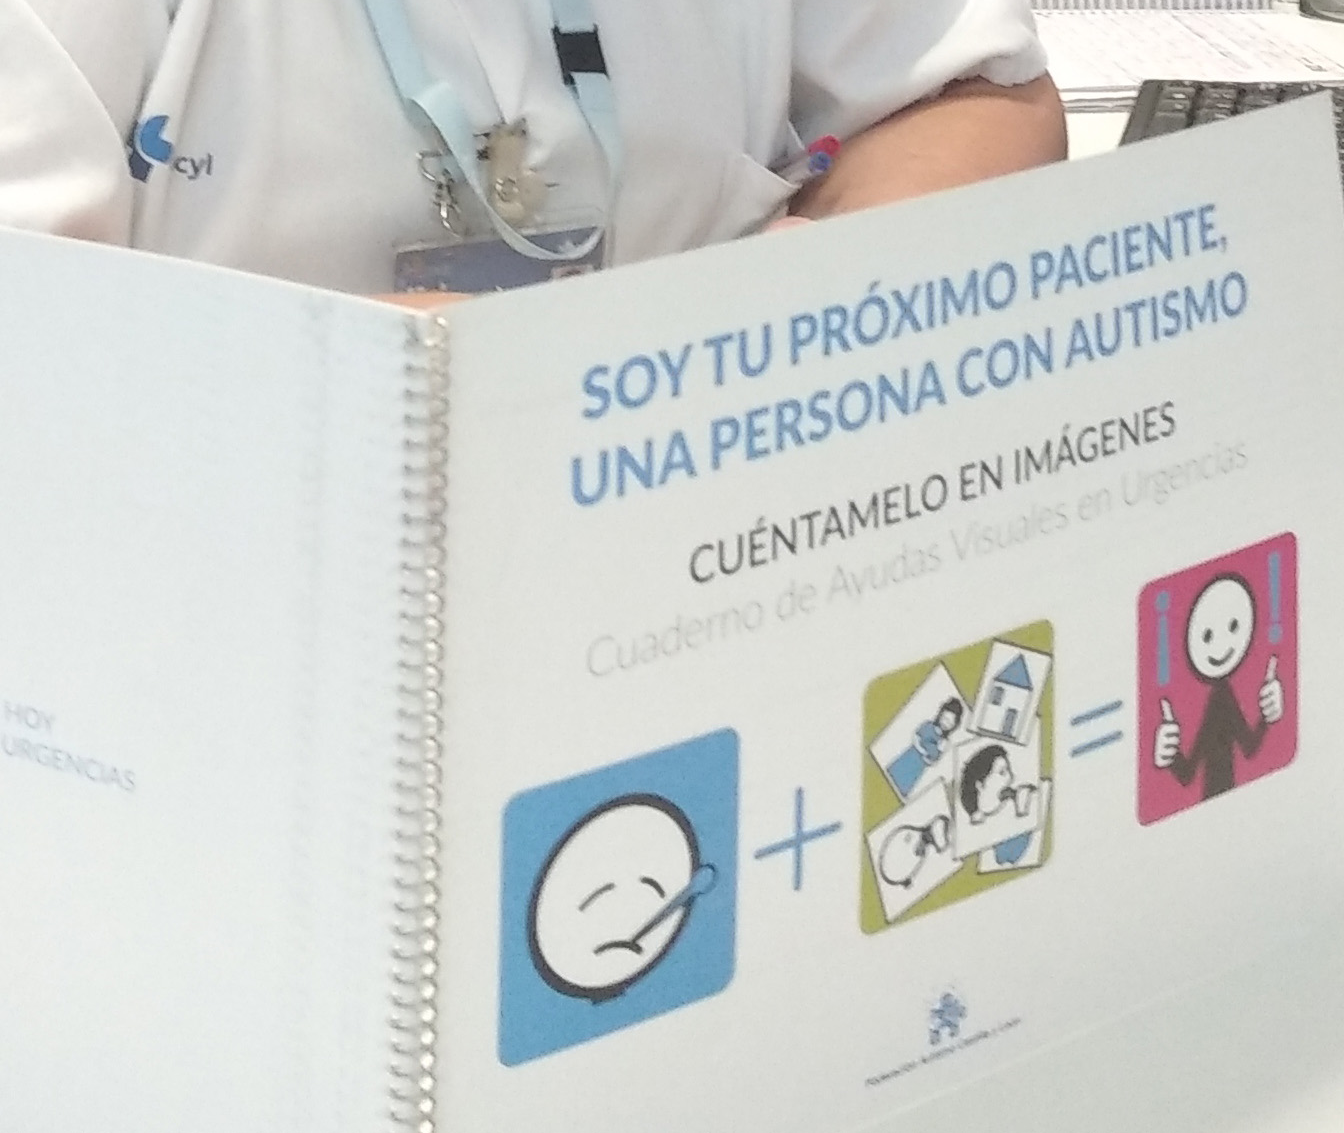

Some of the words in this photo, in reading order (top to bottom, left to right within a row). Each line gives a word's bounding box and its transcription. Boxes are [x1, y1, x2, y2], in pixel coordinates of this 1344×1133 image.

[568, 436, 698, 509] UNA
[708, 361, 948, 471] PERSONA
[955, 329, 1055, 399] CON
[1064, 270, 1251, 370] AUTISMO
[581, 342, 698, 422] SOY
[703, 322, 773, 387] TU
[788, 261, 1018, 368] PRÓXIMO
[1028, 203, 1229, 301] PACIENTE,
[585, 600, 763, 680] Cuaderno
[775, 574, 818, 624] de
[827, 537, 944, 611] Ayudas
[949, 499, 1070, 565] Visuales
[1076, 484, 1112, 519] en
[1119, 440, 1249, 513] Urgencias
[687, 471, 949, 585] CUÉNTAMELO
[958, 455, 1006, 503] EN
[1012, 400, 1177, 487] IMÁGENES
[1, 733, 137, 793] URGENCIAS
[3, 699, 56, 734] HOY
